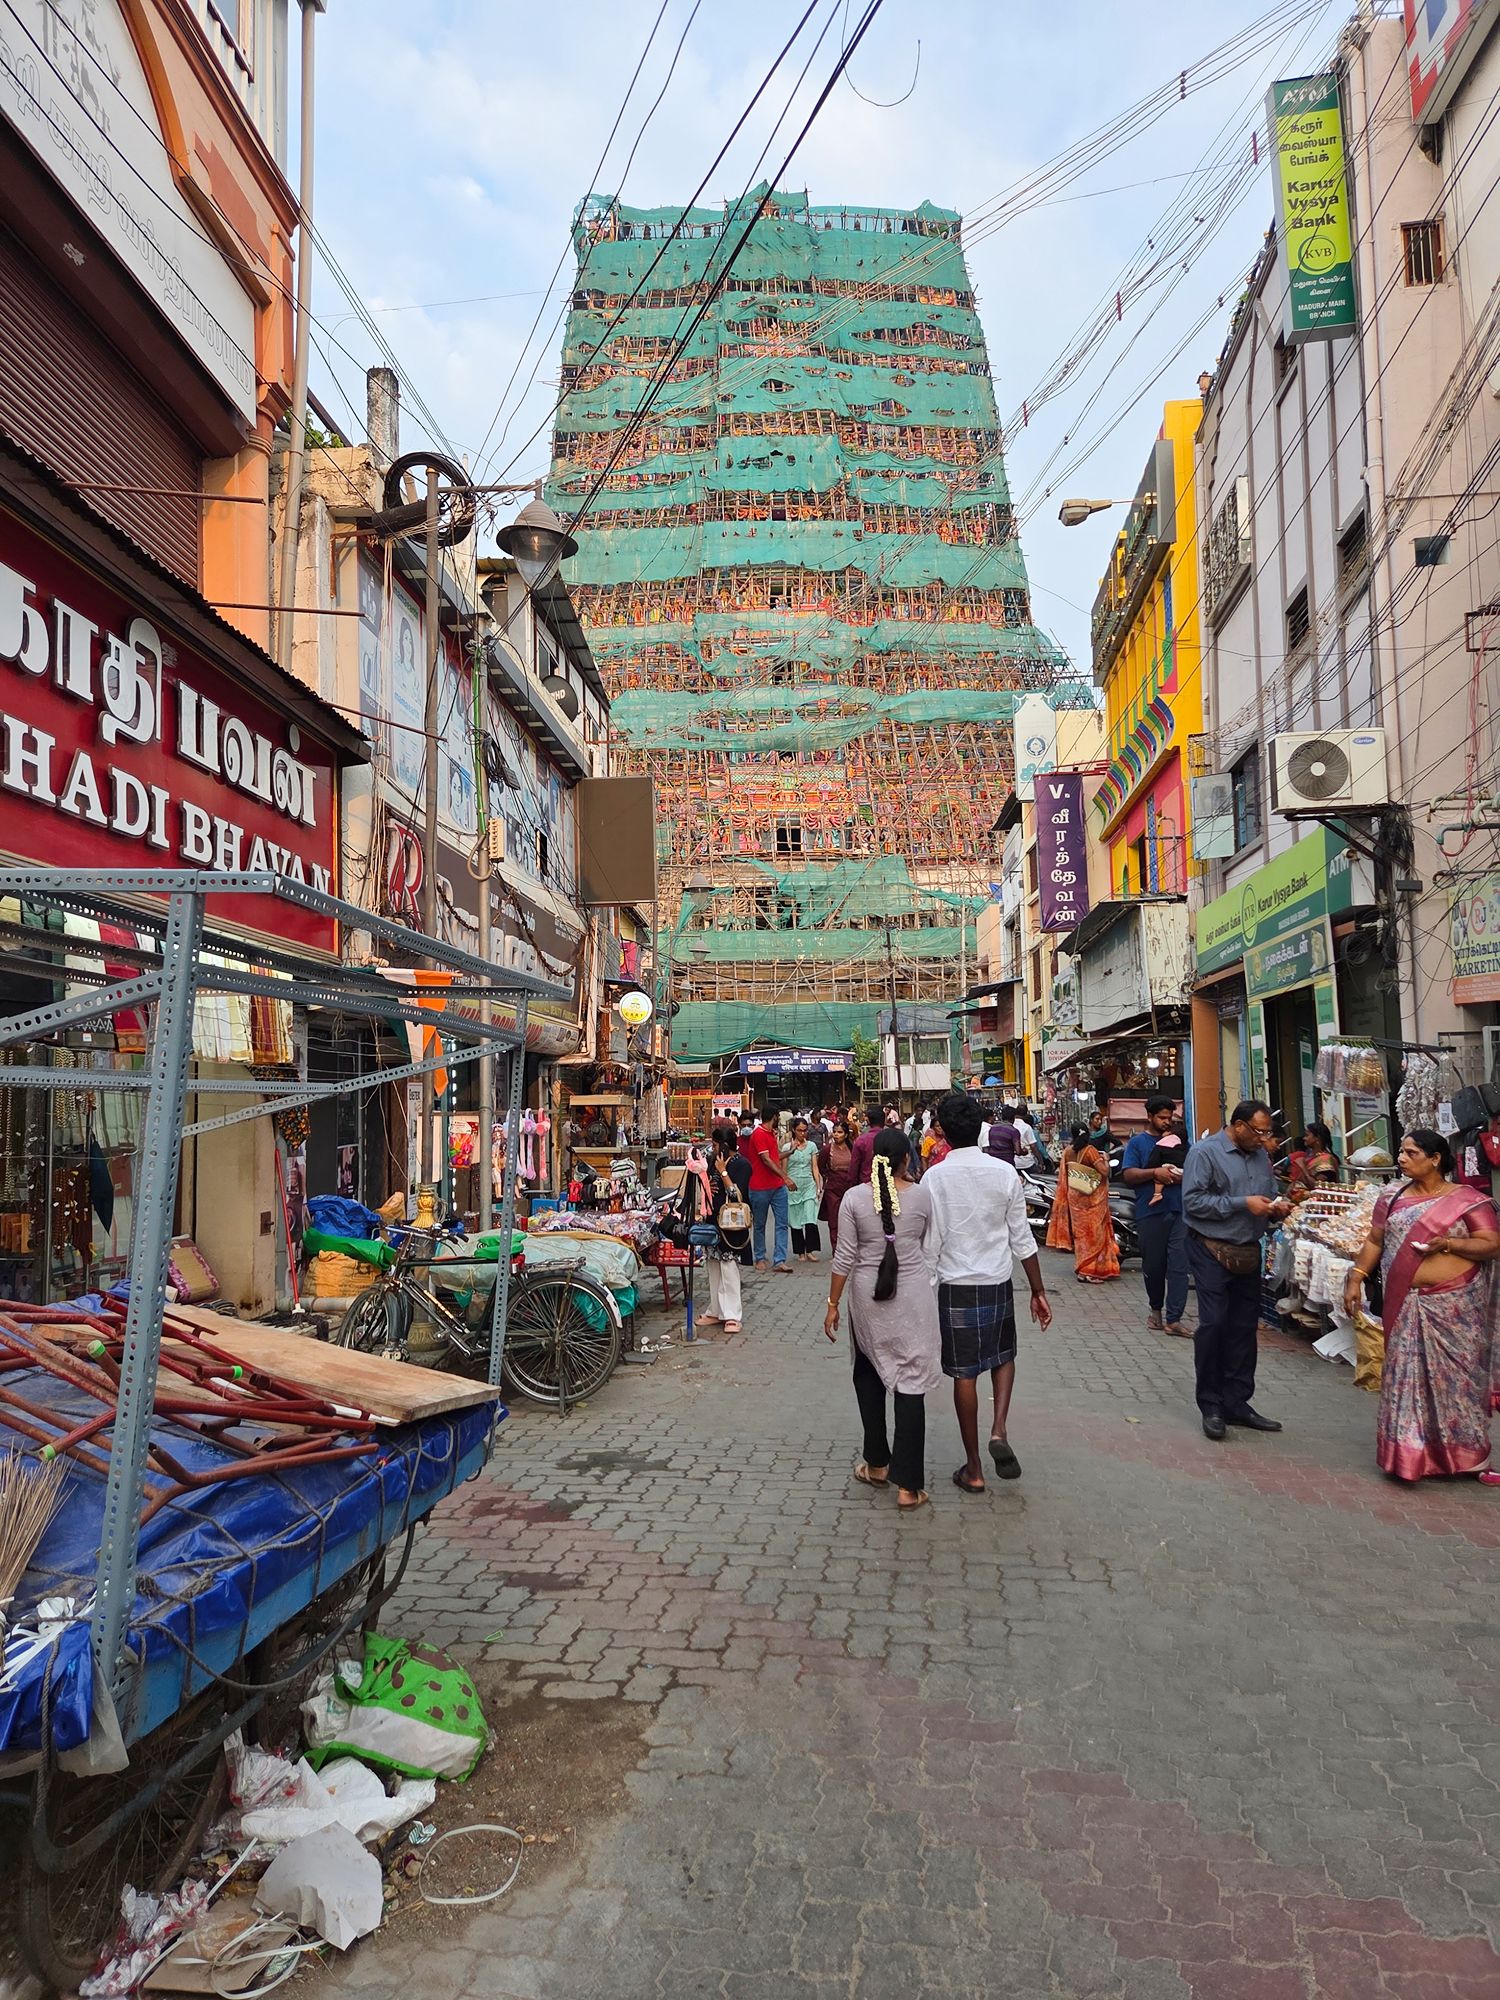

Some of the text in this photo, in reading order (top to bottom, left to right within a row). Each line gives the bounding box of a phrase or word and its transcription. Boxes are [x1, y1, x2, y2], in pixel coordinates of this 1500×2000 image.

[1281, 86, 1328, 106] ATM
[1290, 117, 1323, 135] கரூர்
[1280, 136, 1337, 153] வைஸ்யா
[1290, 149, 1329, 167] பேங்க்
[1287, 179, 1334, 194] Karur
[1287, 195, 1339, 213] Vysya
[1291, 213, 1337, 230] Bank
[1305, 247, 1332, 260] KVB
[1328, 299, 1346, 308] MAIN
[0, 560, 317, 828] காதி பவன்
[1049, 784, 1070, 799] V.
[182, 800, 331, 894] BHAVAN
[1329, 855, 1350, 879] ATM
[1257, 871, 1309, 913] Karur Vysya Bank
